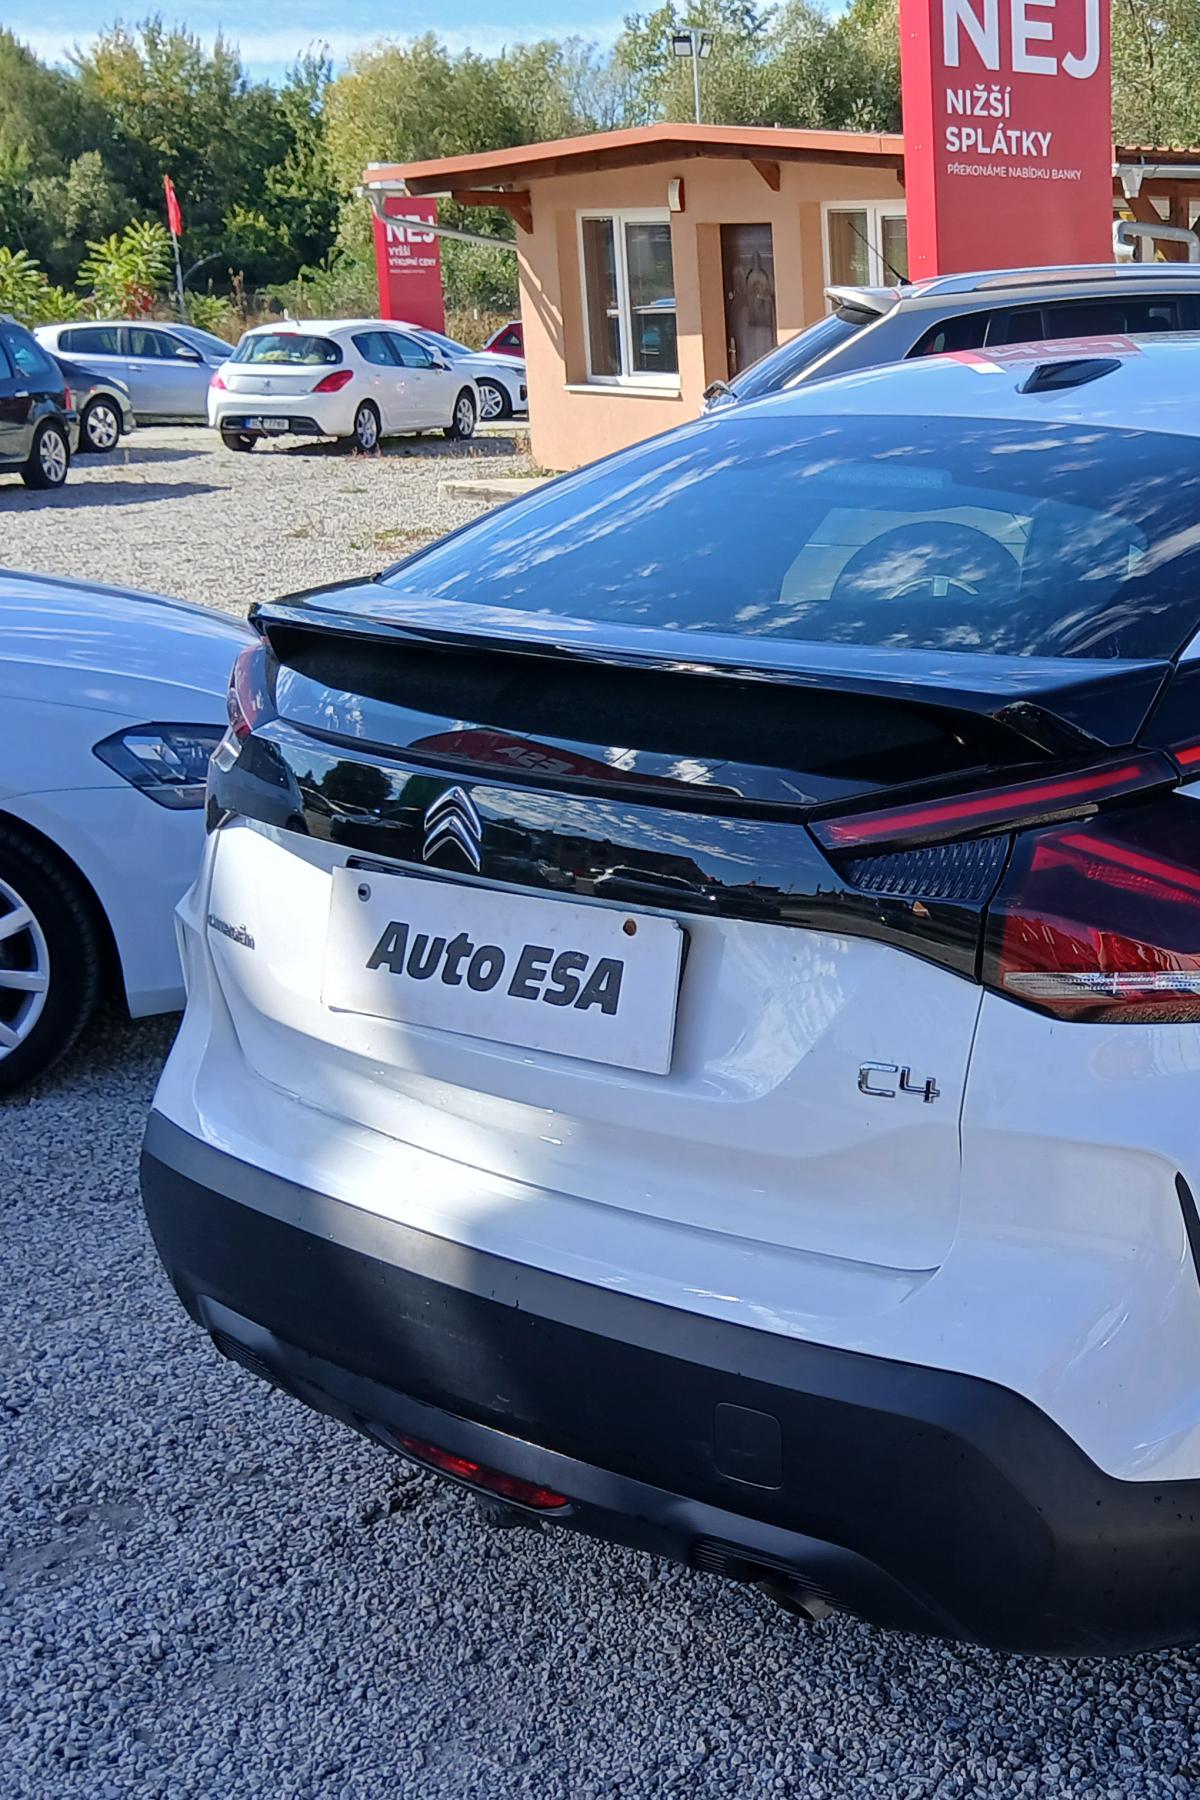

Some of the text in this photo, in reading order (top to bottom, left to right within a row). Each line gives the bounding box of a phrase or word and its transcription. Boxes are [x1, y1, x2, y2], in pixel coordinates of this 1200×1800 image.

[942, 0, 1101, 79] NEJ
[946, 83, 1012, 118] NIŽŠÍ
[945, 122, 1052, 157] SPLÁTKY
[947, 161, 1082, 181] PŘEKONÁME NABÍDKU BANKY
[386, 214, 435, 244] NEJ
[365, 920, 625, 1016] Auto ESA
[857, 1060, 941, 1104] C4
